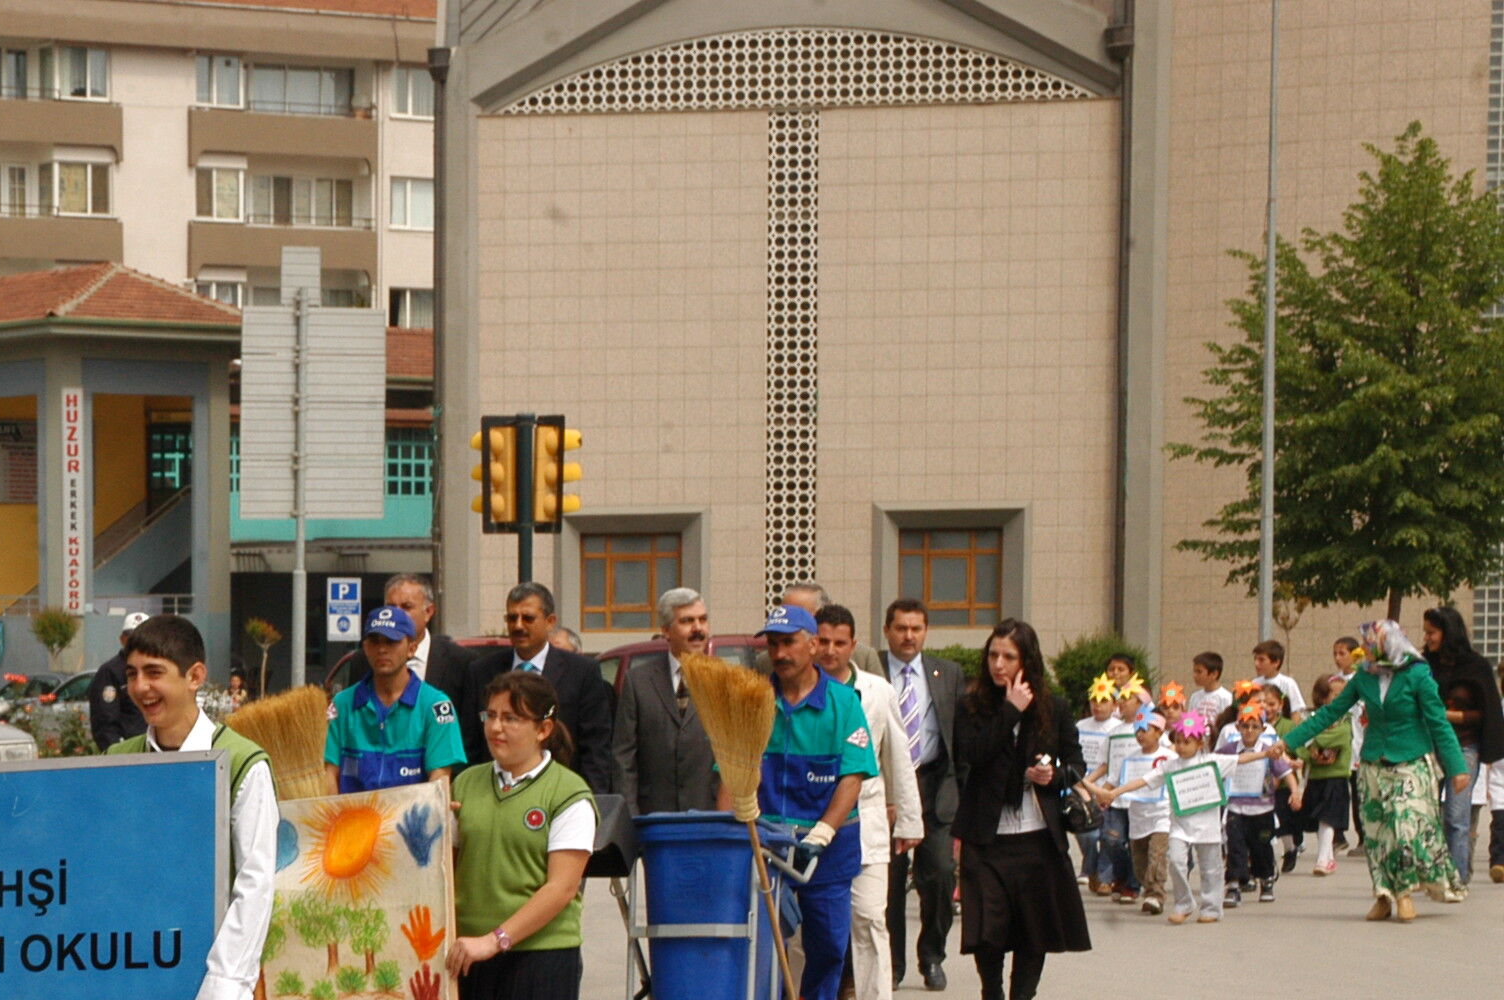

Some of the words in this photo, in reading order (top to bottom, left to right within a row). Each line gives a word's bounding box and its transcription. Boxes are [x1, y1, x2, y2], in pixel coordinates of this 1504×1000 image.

[65, 394, 79, 473] HUZUR
[69, 479, 77, 531] ERKEK
[339, 584, 350, 600] P
[20, 930, 182, 973] OKULU
